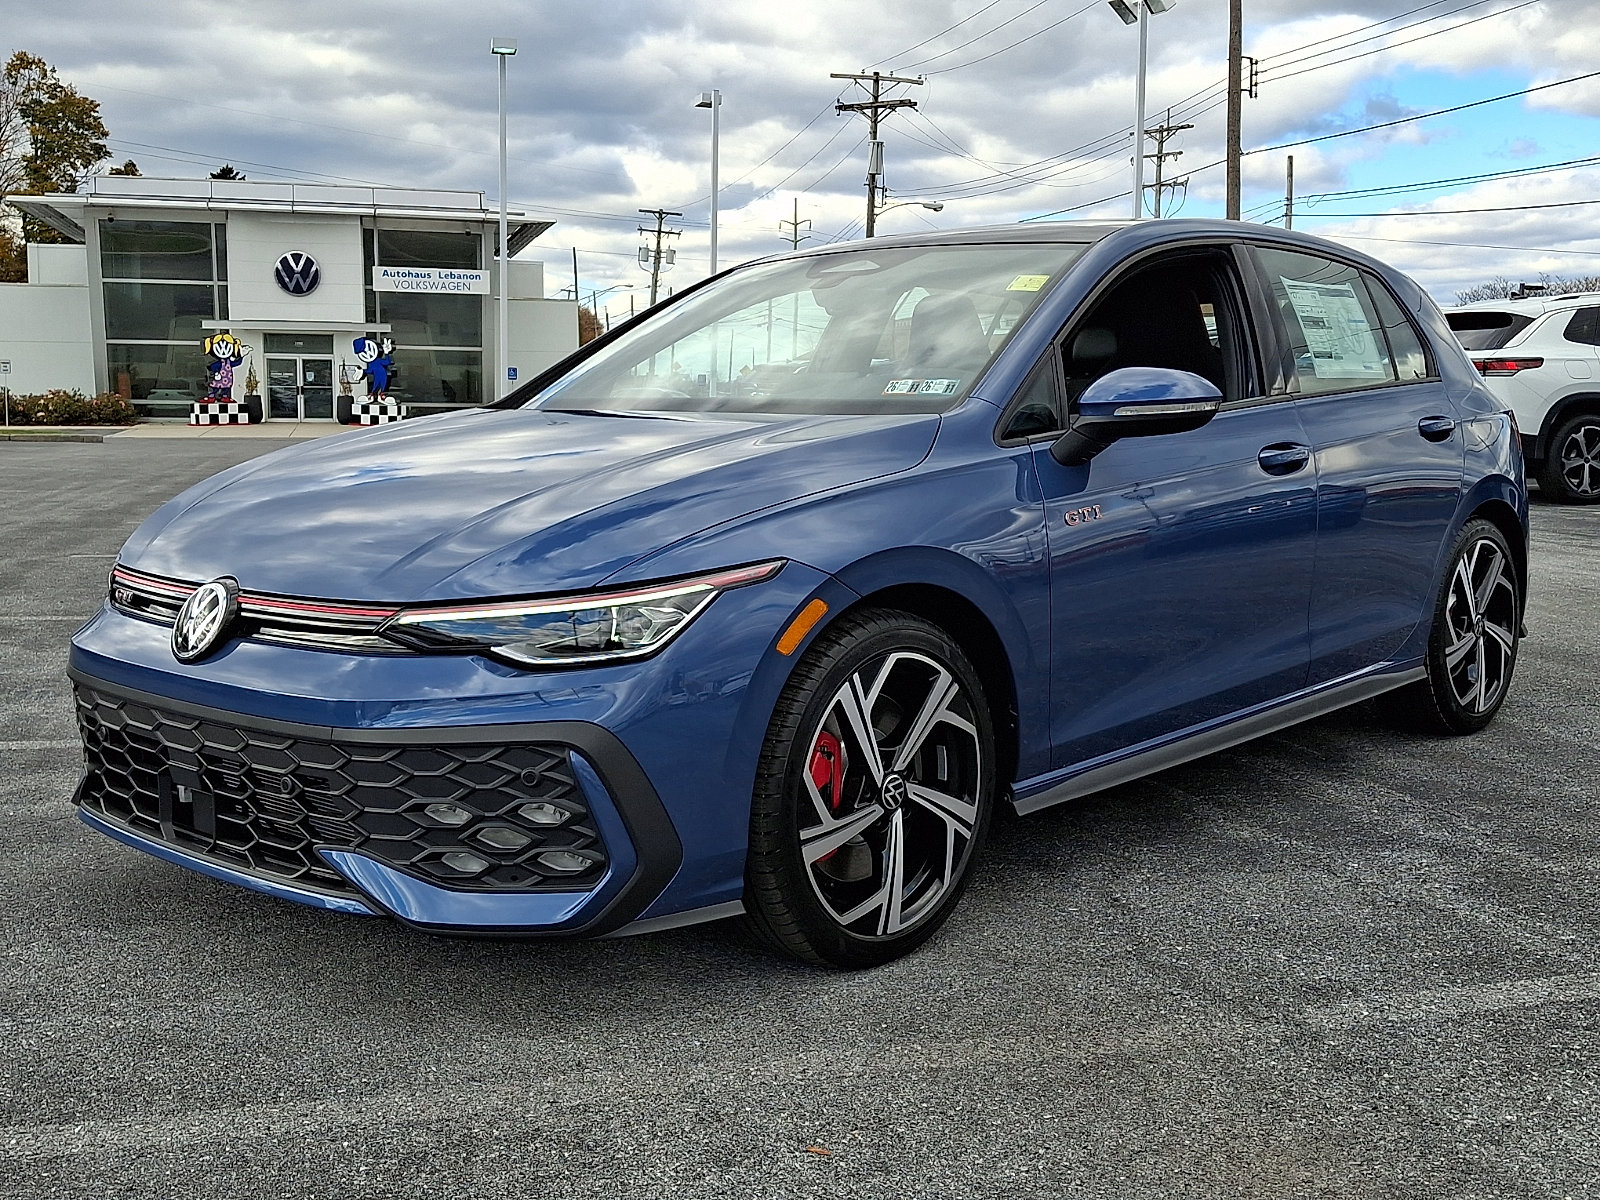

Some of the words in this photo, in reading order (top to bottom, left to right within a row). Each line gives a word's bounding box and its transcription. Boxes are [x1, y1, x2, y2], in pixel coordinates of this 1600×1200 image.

[275, 251, 320, 296] VW
[382, 270, 432, 279] Autohaus
[438, 271, 481, 281] Lebanon
[393, 279, 471, 291] VOLKSWAGEN
[886, 381, 899, 393] 26
[907, 383, 920, 393] 11
[921, 381, 934, 392] 26
[944, 383, 956, 394] 11
[1064, 504, 1102, 526] GTI
[172, 582, 227, 658] VW
